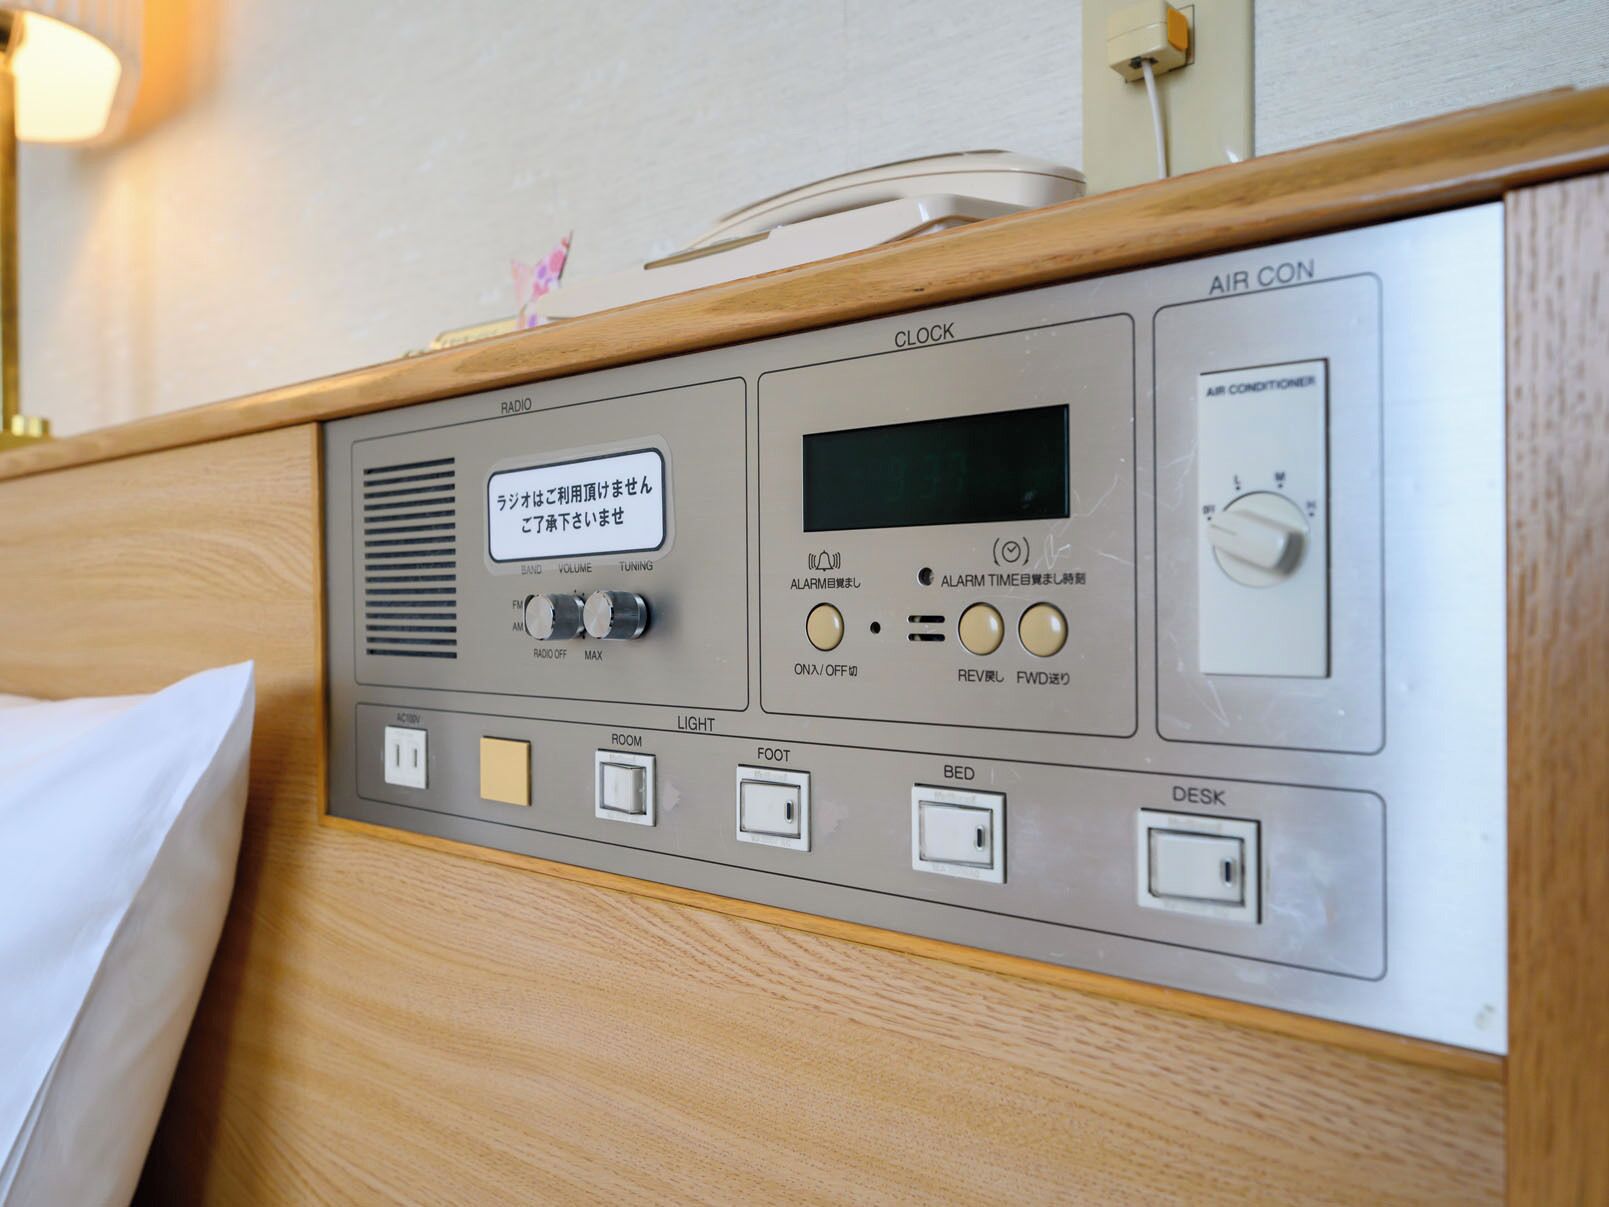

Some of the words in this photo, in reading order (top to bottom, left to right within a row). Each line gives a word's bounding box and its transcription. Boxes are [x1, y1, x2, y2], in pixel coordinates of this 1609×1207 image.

[1209, 271, 1249, 296] AIR
[1258, 259, 1314, 287] CON
[895, 322, 954, 347] CLOCK
[1206, 384, 1226, 397] AIR
[1229, 376, 1315, 395] CONDITIONER
[501, 397, 532, 414] RADIO
[497, 475, 653, 511] ラジオはご利用頂けません
[522, 506, 624, 534] ご了承下さいませ
[521, 564, 542, 575] BAND
[558, 562, 592, 574] VOLUME
[619, 560, 653, 572] TUNING
[941, 574, 985, 588] ALARM
[512, 600, 523, 609] FM
[512, 622, 523, 631] AM
[533, 648, 553, 659] RADIO
[555, 649, 567, 660] OFF
[585, 650, 603, 661] MAX
[958, 669, 1004, 683] REV戻し
[1017, 671, 1071, 686] FWD送り
[677, 715, 716, 732] LIGHT
[611, 733, 643, 747] ROOM
[757, 747, 791, 762] FOOT
[943, 764, 976, 781] BED
[1172, 785, 1227, 807] DESK
